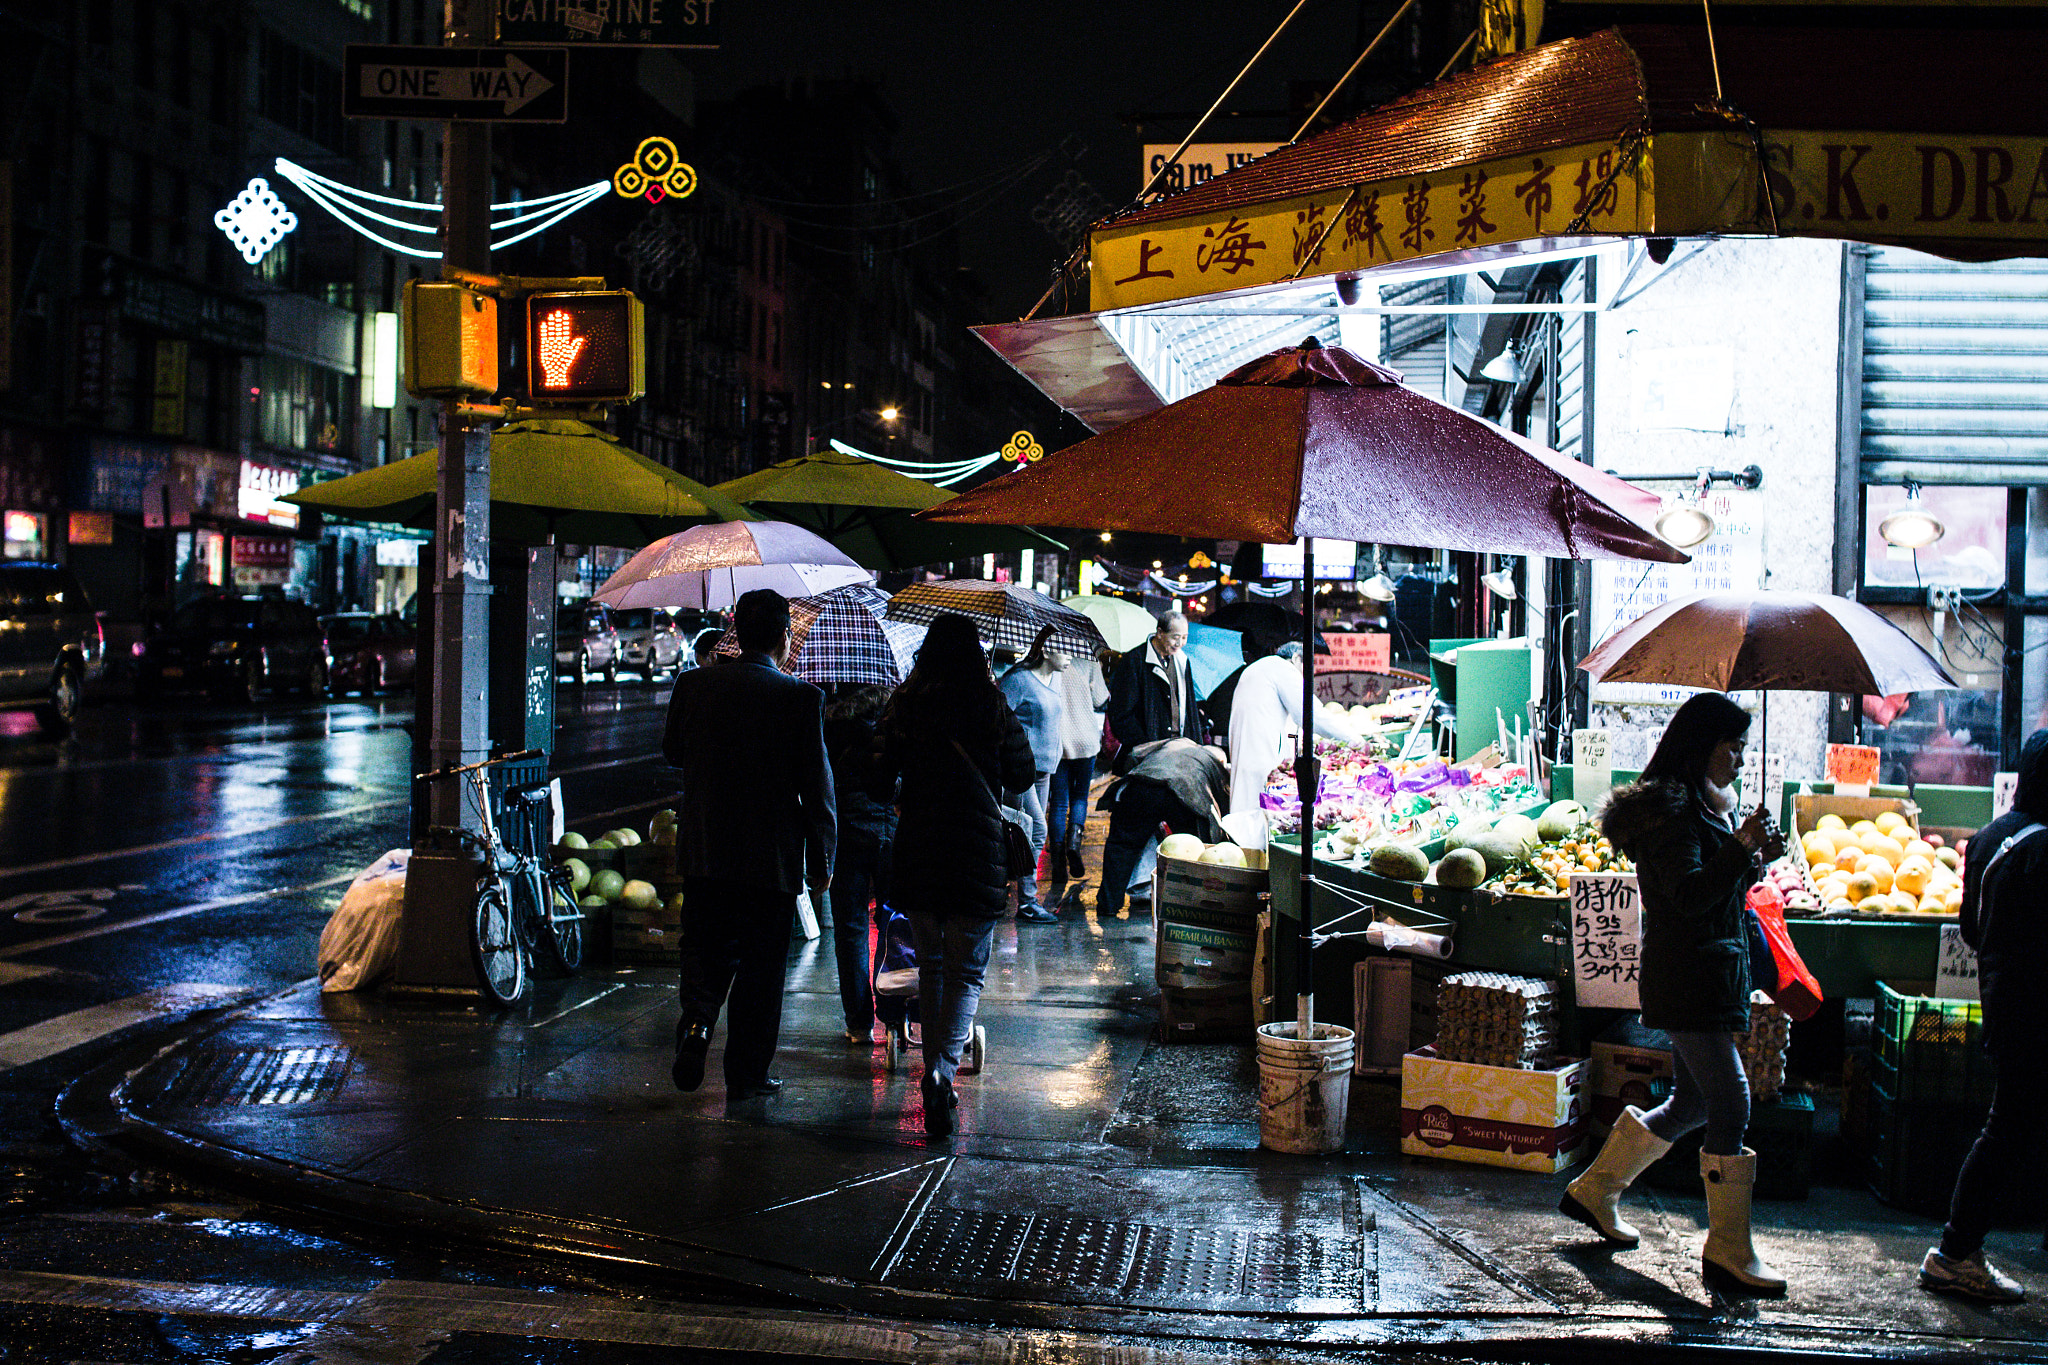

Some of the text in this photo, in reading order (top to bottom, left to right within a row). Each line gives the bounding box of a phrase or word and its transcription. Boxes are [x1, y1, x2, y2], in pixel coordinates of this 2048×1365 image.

[682, 0, 716, 25] ST
[377, 68, 532, 98] ONE WAY
[1150, 154, 1213, 194] Sam
[1758, 143, 1889, 222] S.K.
[1169, 928, 1212, 945] PREMIUM
[1423, 1113, 1449, 1130] Rice
